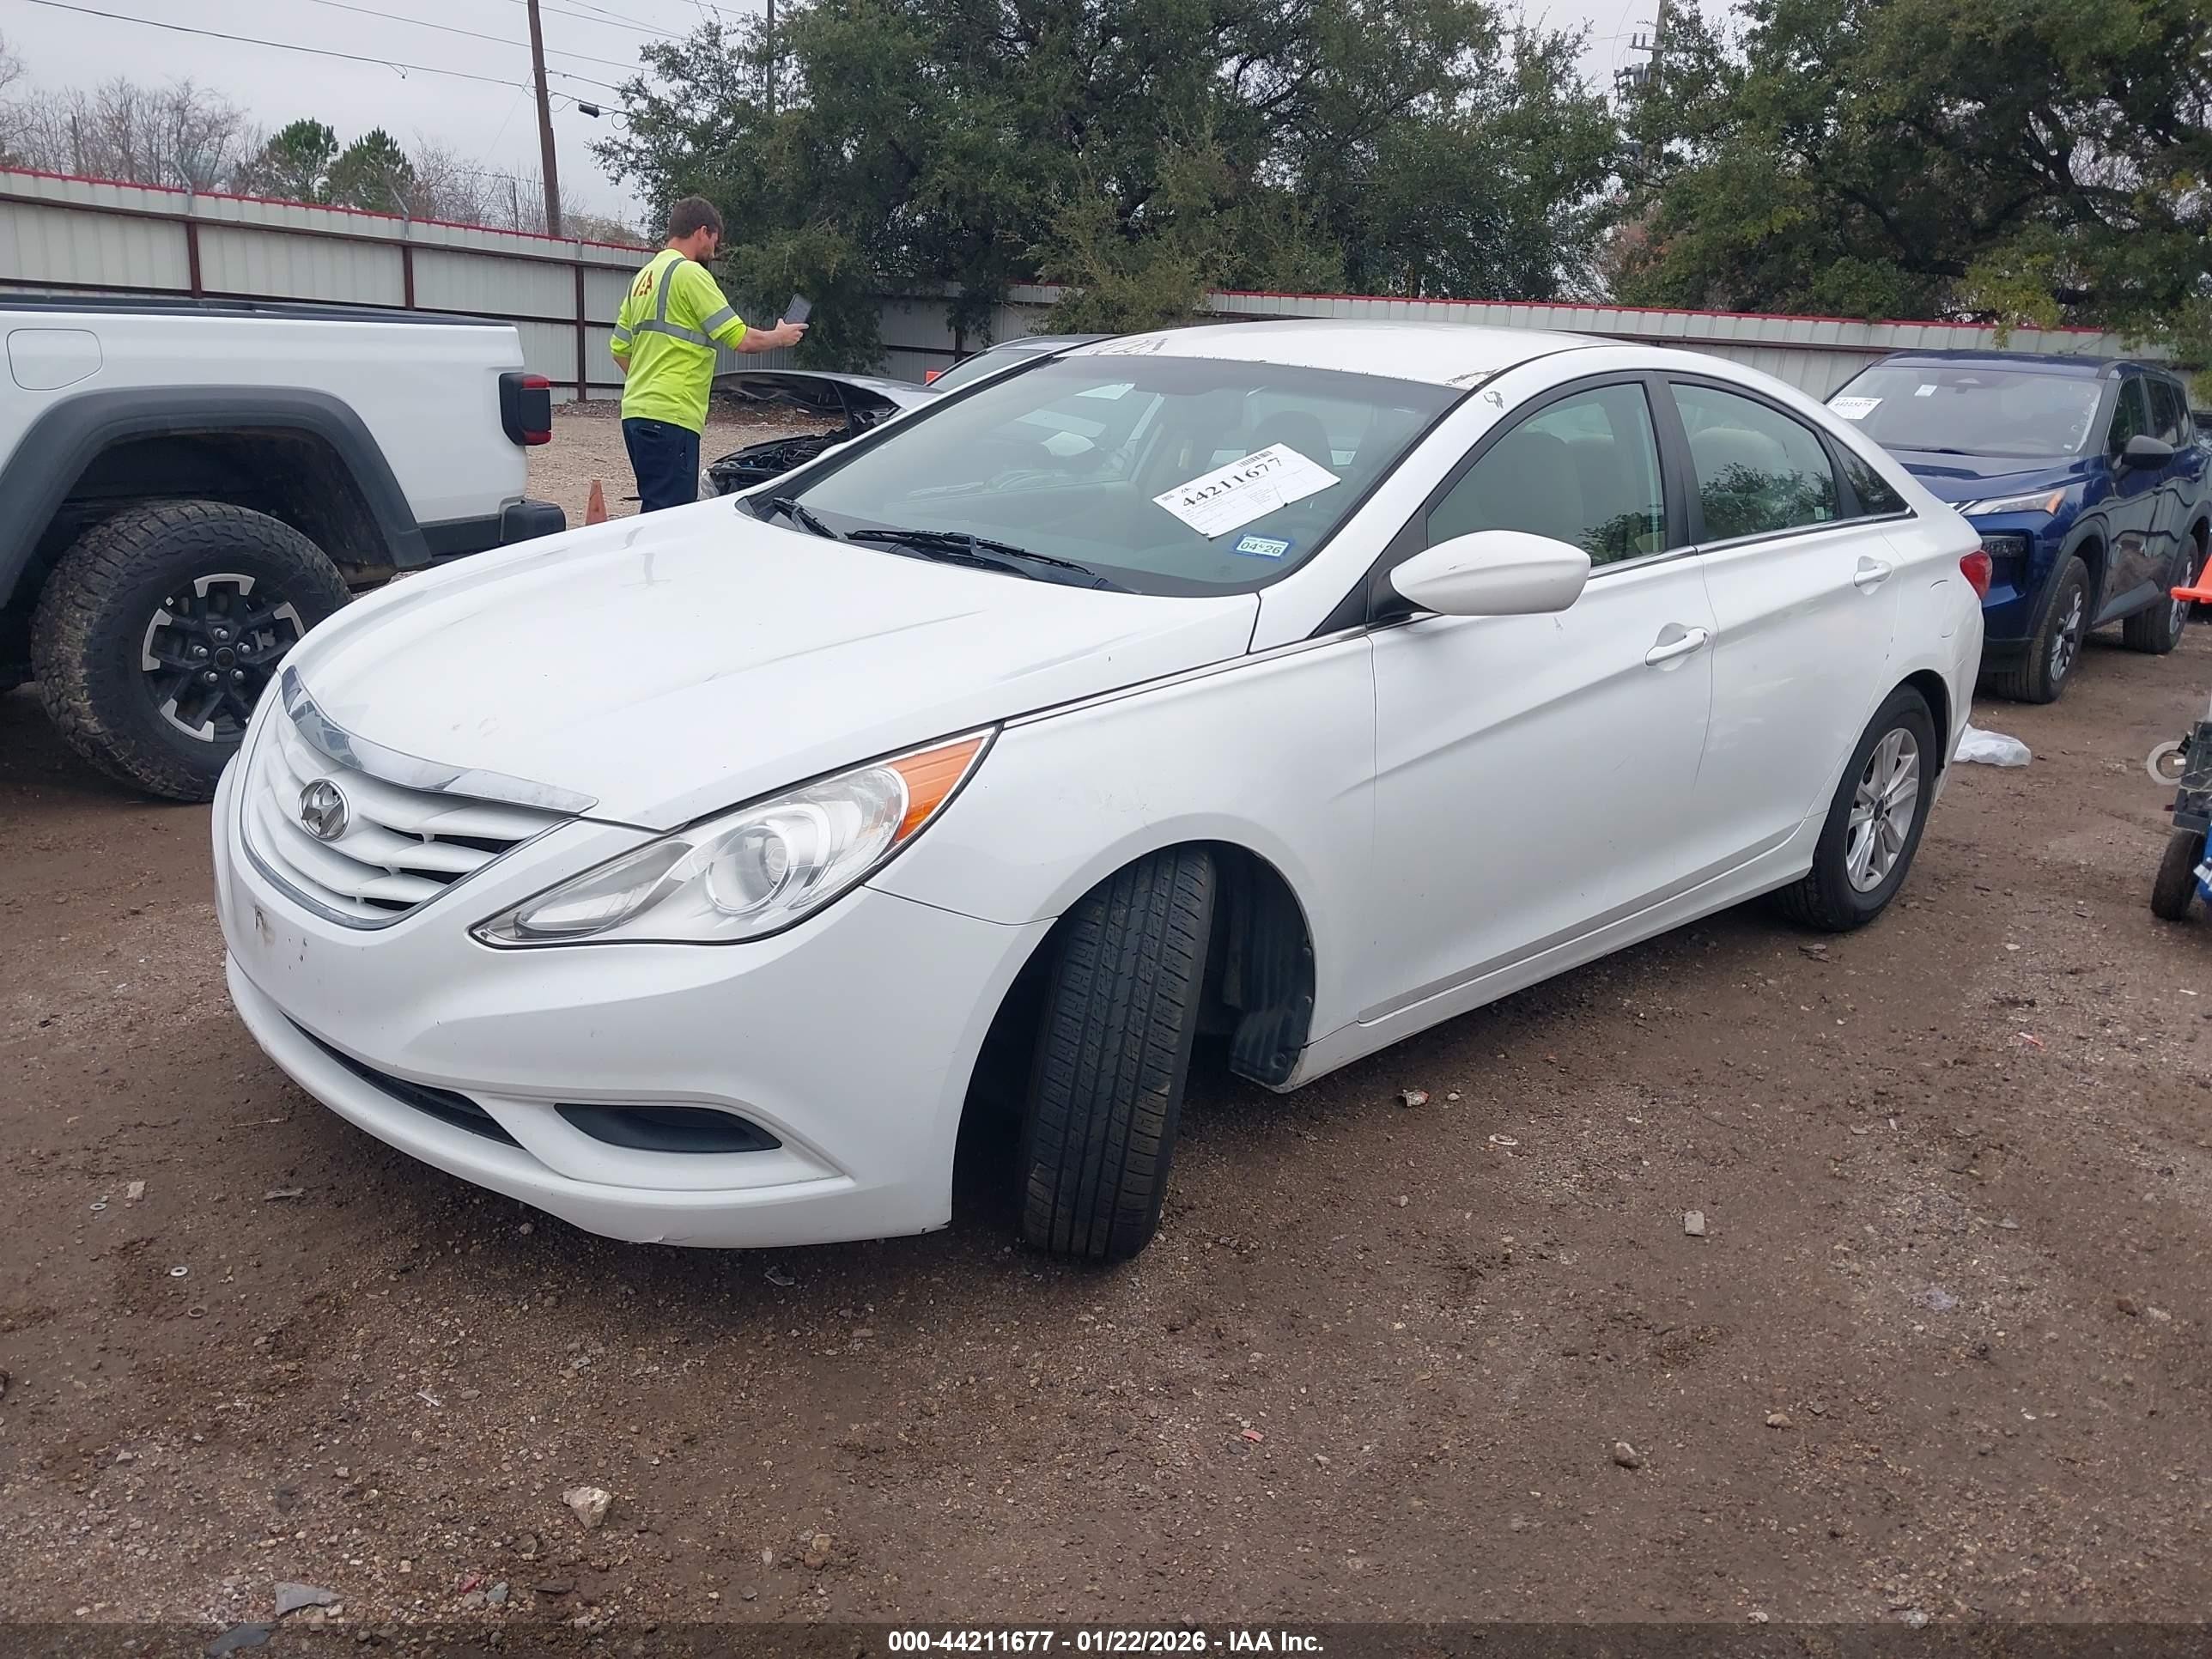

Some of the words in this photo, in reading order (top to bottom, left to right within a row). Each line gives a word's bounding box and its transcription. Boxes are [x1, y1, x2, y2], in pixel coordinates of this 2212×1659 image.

[1182, 457, 1281, 507] 44211677
[1240, 542, 1258, 550] 04
[1263, 544, 1282, 555] 26
